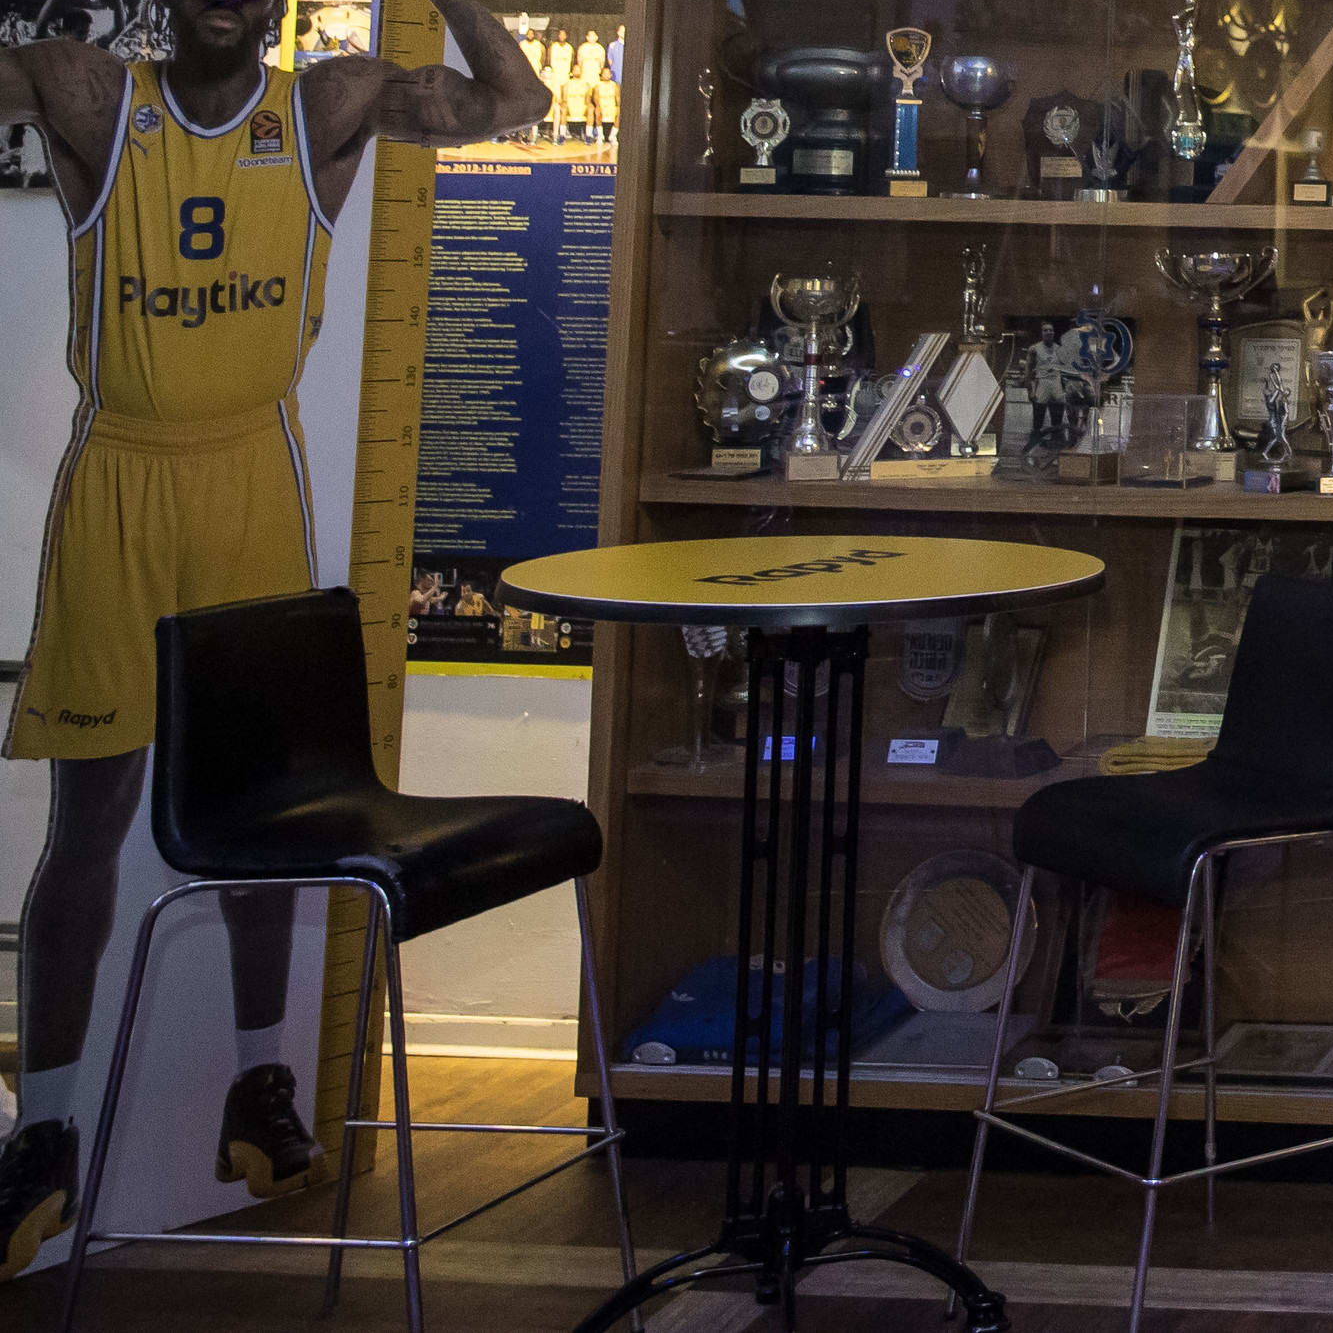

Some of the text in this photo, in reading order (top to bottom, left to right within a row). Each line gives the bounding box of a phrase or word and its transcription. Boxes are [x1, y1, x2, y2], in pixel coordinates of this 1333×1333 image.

[416, 186, 428, 209] 160
[179, 196, 225, 260] 8
[413, 245, 424, 268] 150
[119, 270, 286, 328] Playtika
[409, 304, 420, 328] 140
[405, 365, 416, 389] 130
[402, 425, 413, 449] 120
[398, 484, 409, 508] 110
[394, 545, 405, 567] 100
[692, 548, 909, 586] Rapyd
[391, 612, 402, 629] 90
[387, 672, 398, 690] 80
[57, 707, 117, 728] Rapyd
[383, 733, 394, 751] 70
